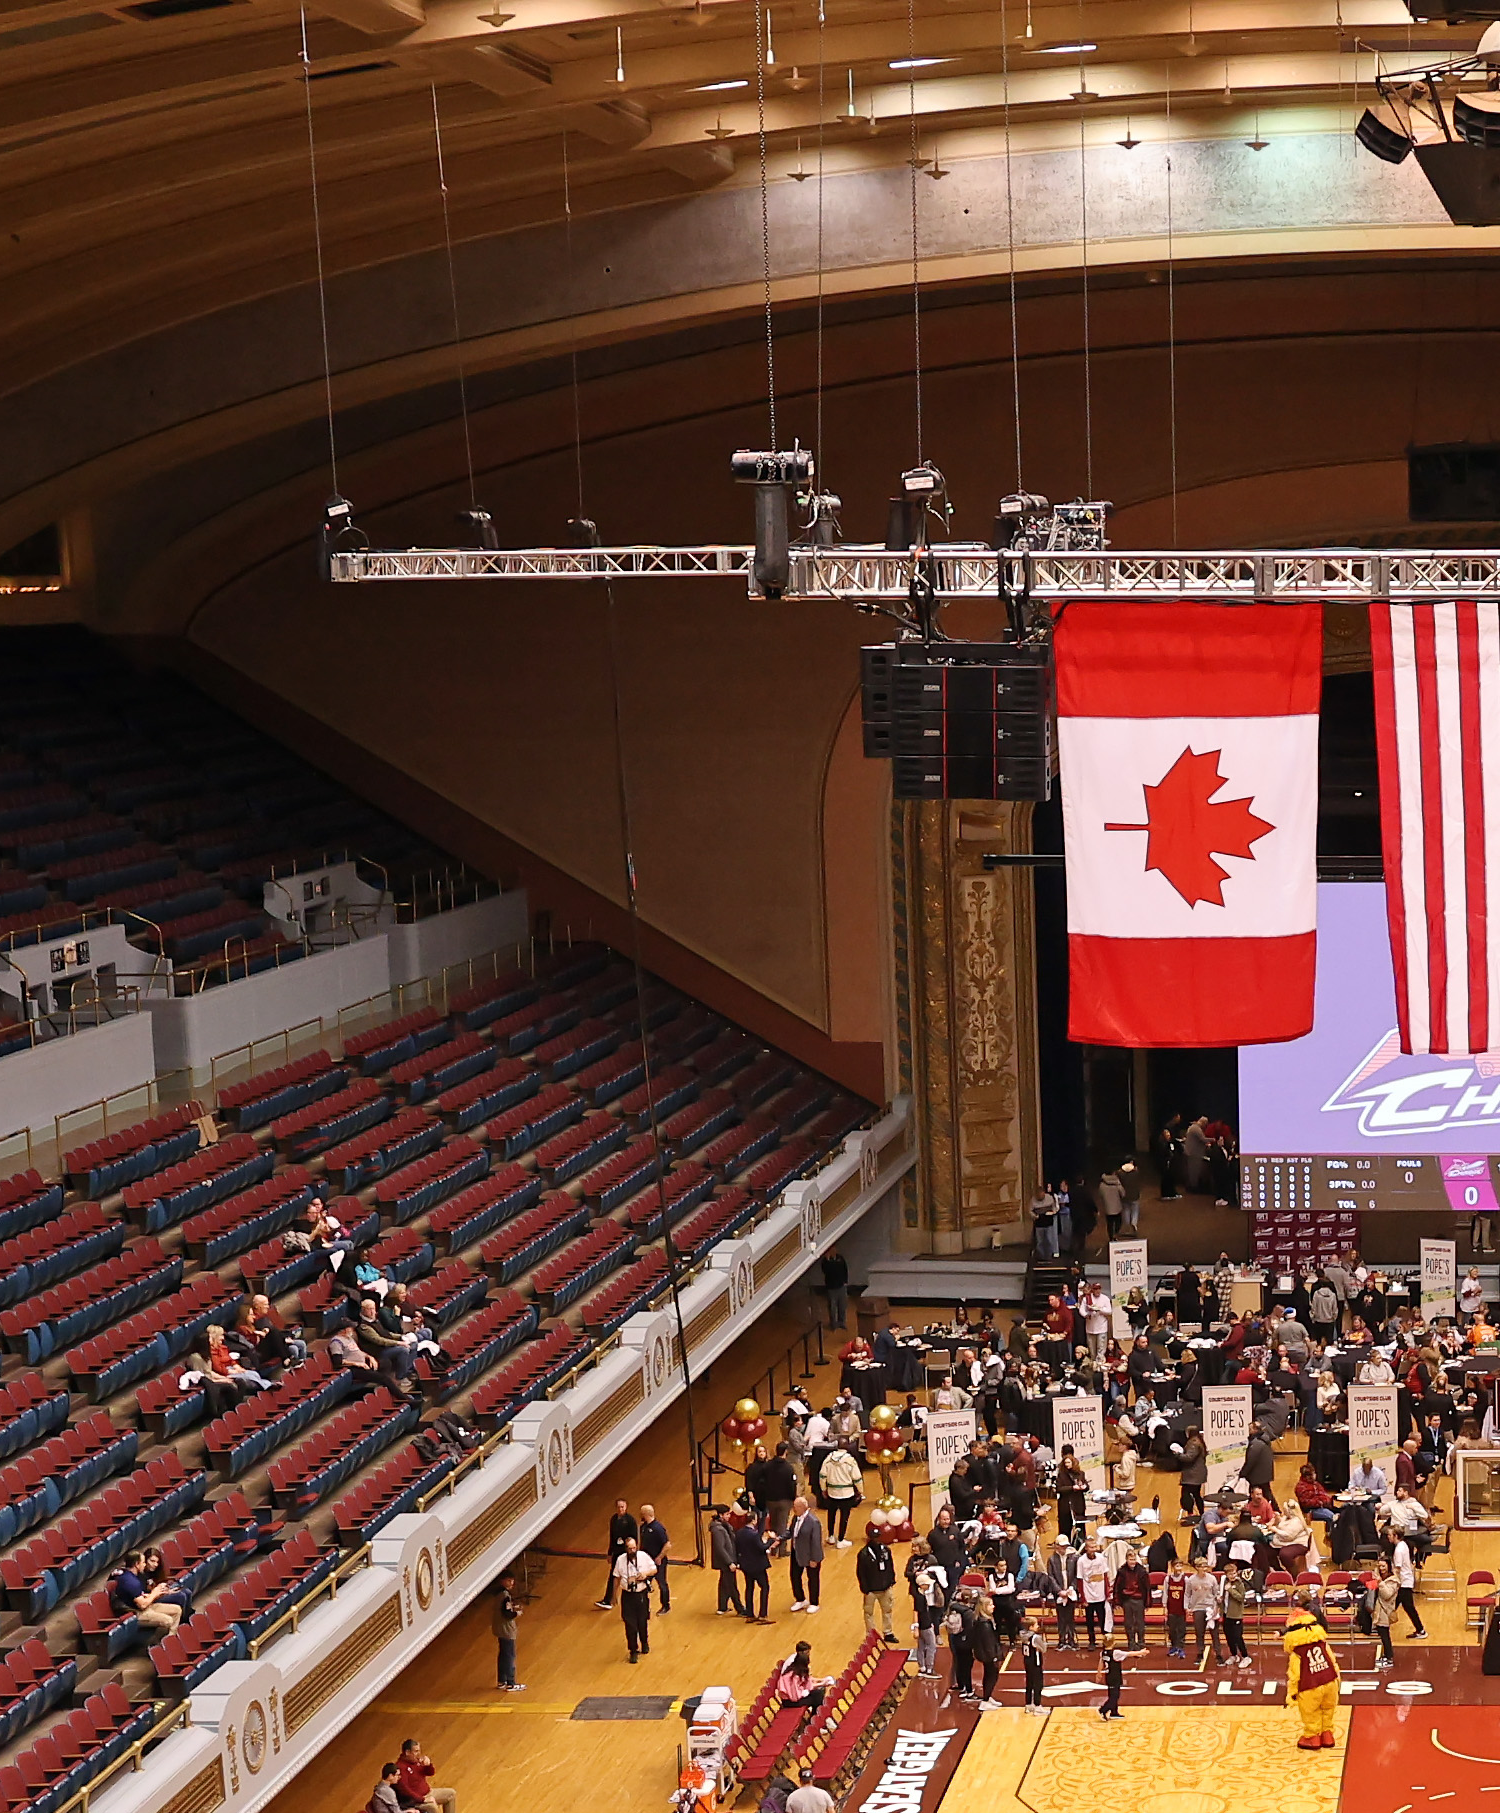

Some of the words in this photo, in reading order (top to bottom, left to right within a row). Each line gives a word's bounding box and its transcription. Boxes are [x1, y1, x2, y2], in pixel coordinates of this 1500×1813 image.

[1356, 1161, 1371, 1169] 0.0
[1397, 1160, 1422, 1168] FOULS
[1361, 1180, 1376, 1189] 0.0
[1404, 1171, 1414, 1183] 0
[1464, 1186, 1479, 1205] 0
[1337, 1201, 1357, 1209] TOL
[1369, 1201, 1376, 1209] 6
[1116, 1260, 1142, 1276] POPE'S
[1425, 1257, 1450, 1275] POPE'S
[1211, 1409, 1244, 1428] POPE'S
[1356, 1409, 1390, 1428] POPE'S
[1061, 1420, 1095, 1440] POPE'S
[936, 1434, 969, 1456] POPE'S
[1306, 1646, 1325, 1667] 12
[1155, 1680, 1433, 1696] CLIFS
